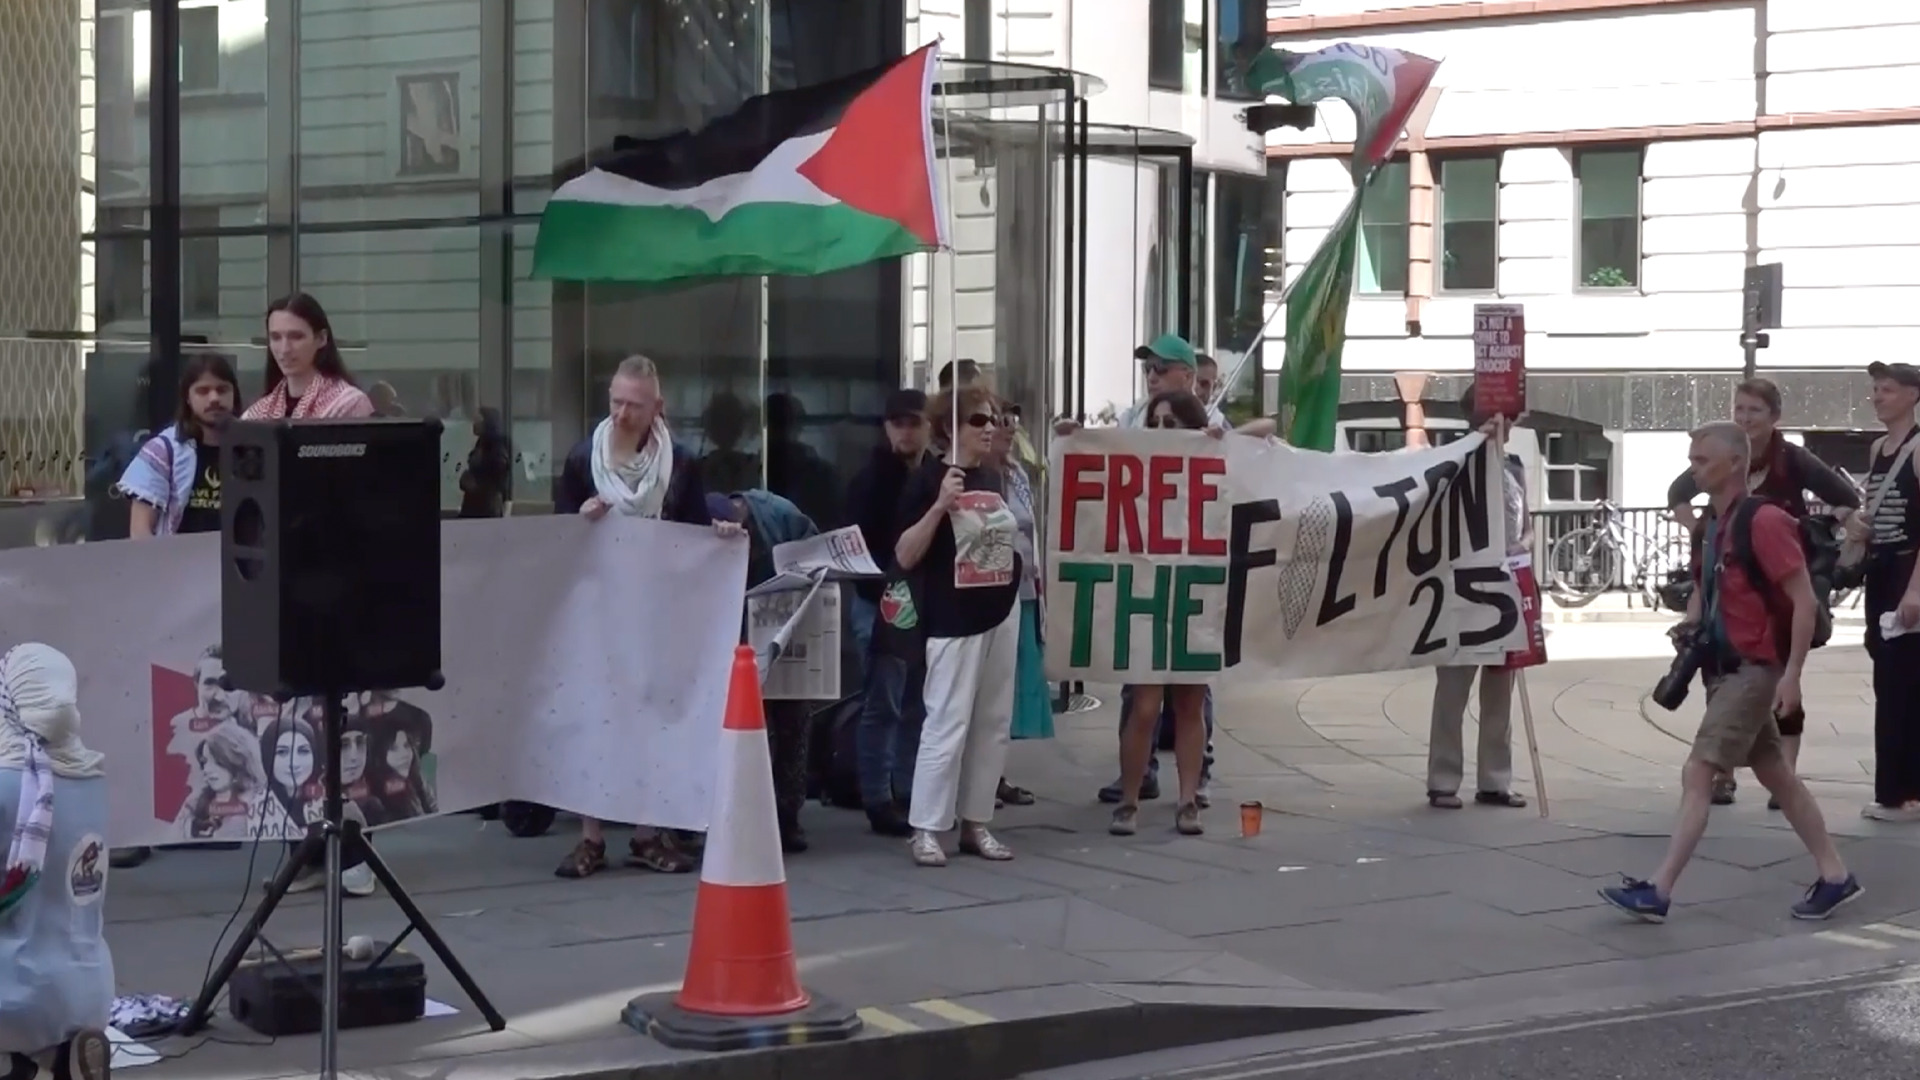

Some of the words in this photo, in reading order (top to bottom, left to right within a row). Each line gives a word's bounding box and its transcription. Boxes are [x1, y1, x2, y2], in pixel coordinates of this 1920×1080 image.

[1059, 453, 1228, 557] FREE
[1058, 561, 1227, 672] THE
[1408, 566, 1520, 656] 25
